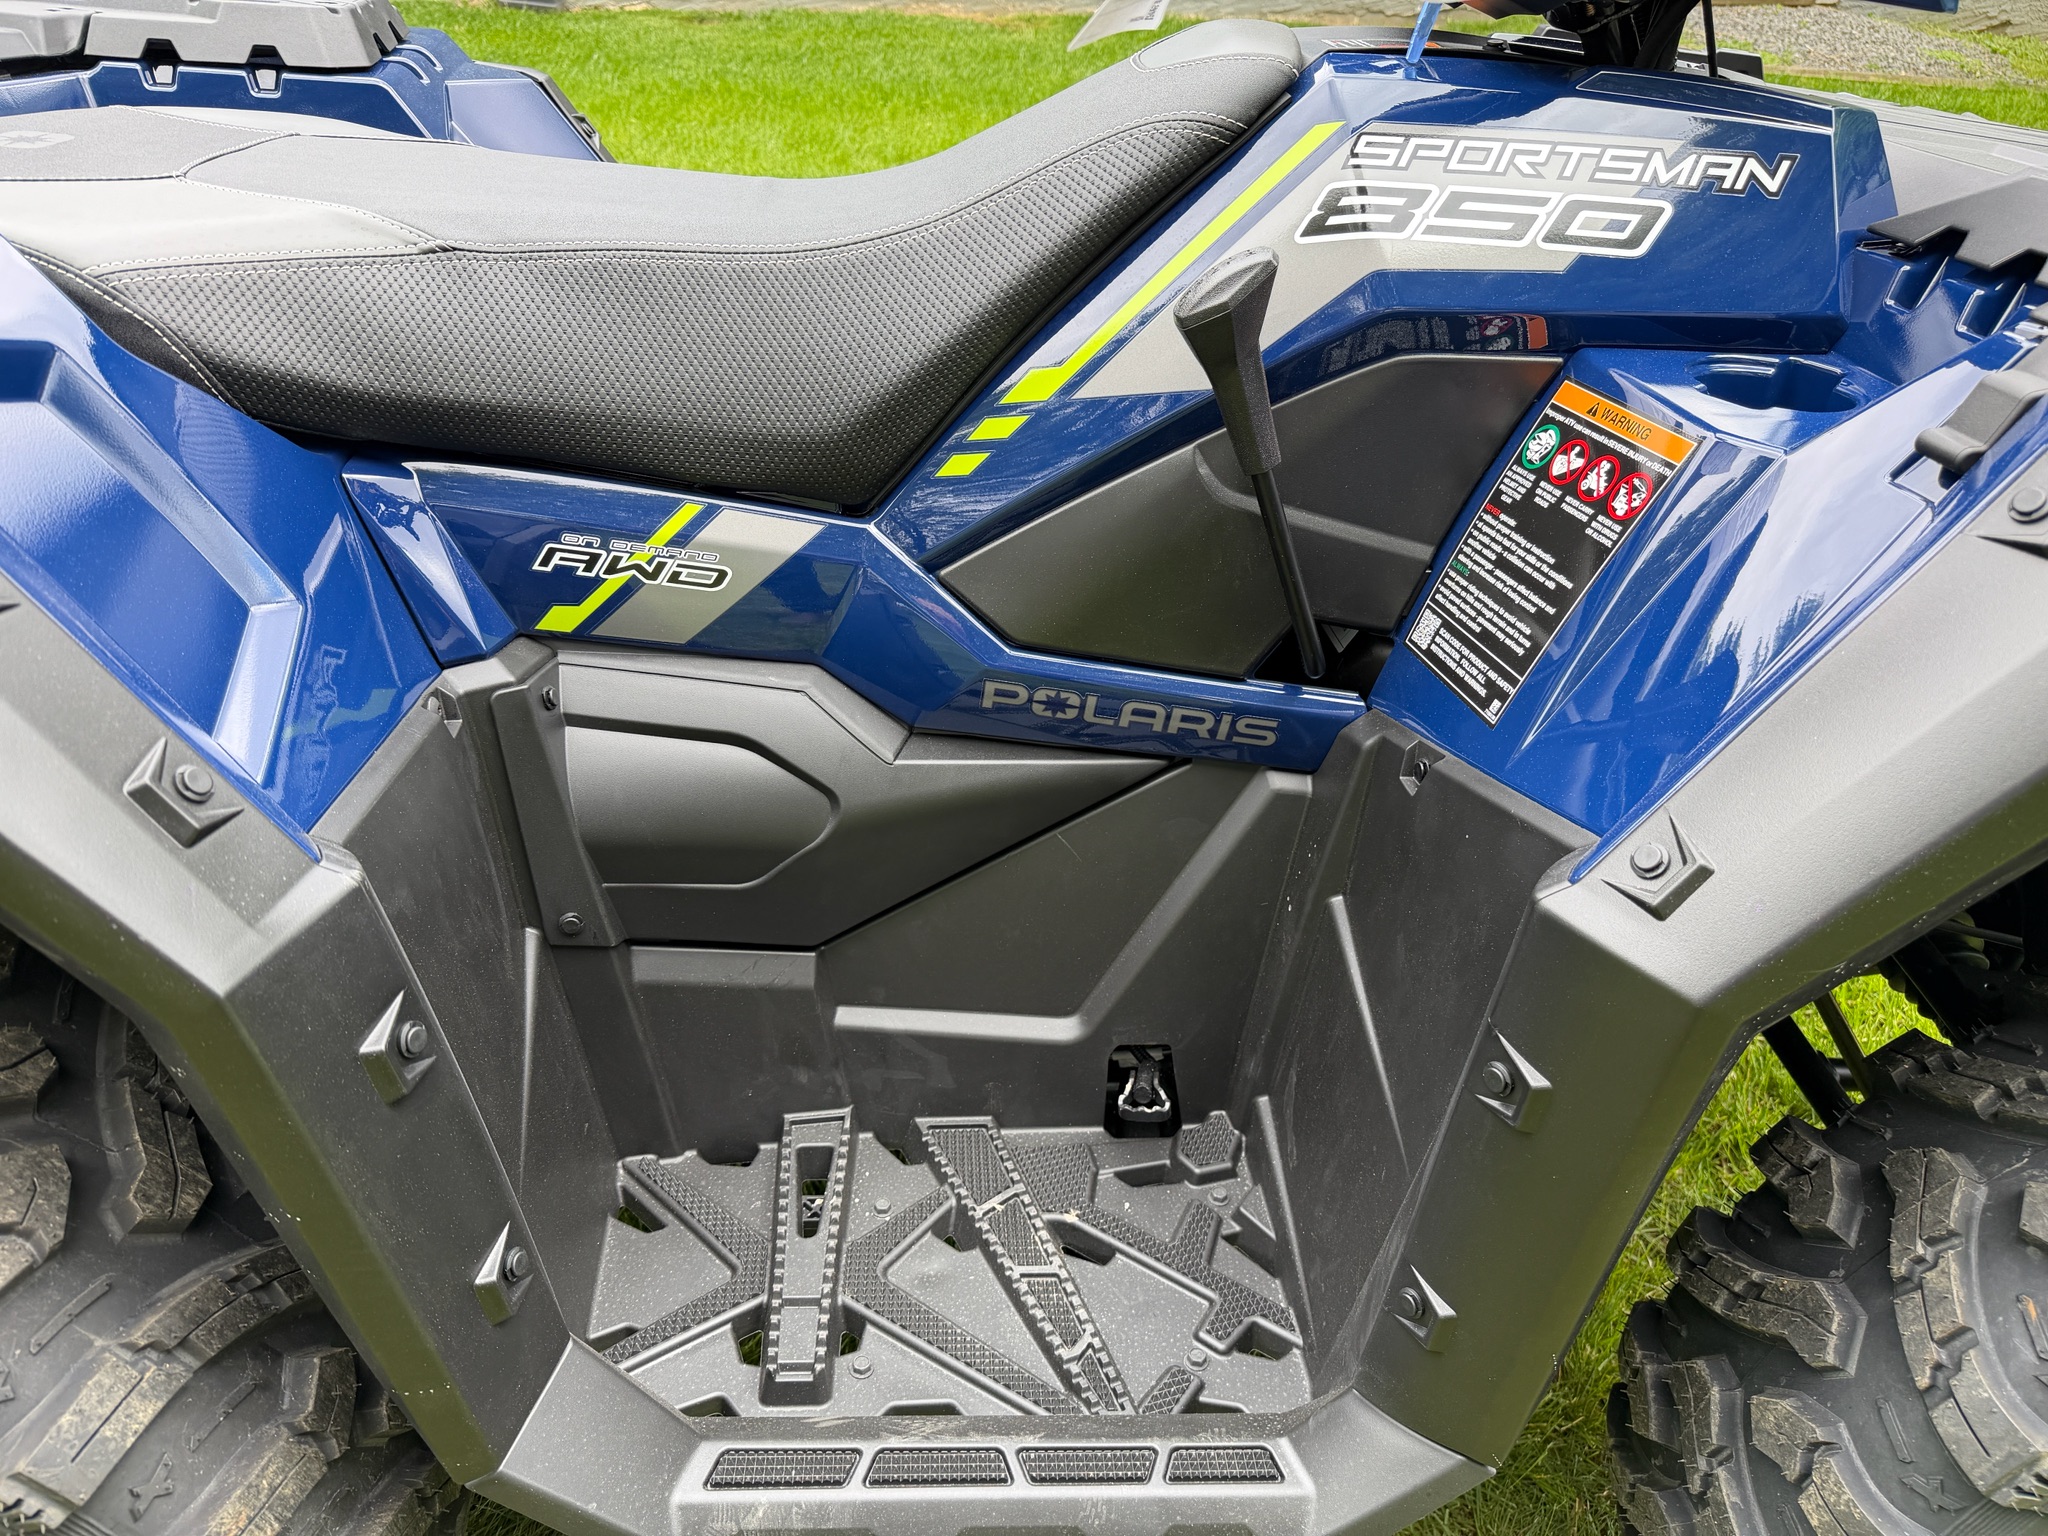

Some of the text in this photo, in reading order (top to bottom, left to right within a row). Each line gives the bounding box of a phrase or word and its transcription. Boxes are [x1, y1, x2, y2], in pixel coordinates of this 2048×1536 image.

[1342, 131, 1800, 199] SPORTSMAN
[1294, 180, 1674, 259] 850
[1600, 407, 1651, 440] WARNING
[1546, 408, 1566, 421] Improper
[1564, 417, 1576, 426] ATV
[1573, 423, 1583, 431] use
[1581, 427, 1591, 435] can
[1589, 432, 1605, 442] result
[1607, 439, 1629, 454] SEVERE
[1627, 450, 1648, 464] INJURY
[1645, 459, 1653, 467] or
[1650, 461, 1672, 476] DEATH
[1511, 464, 1536, 481] ALWAYS USE
[1539, 480, 1554, 492] NEVER
[1500, 494, 1512, 504] GEAR
[1564, 495, 1594, 515] NEVER CARRY
[1485, 503, 1500, 516] NEVER
[1560, 502, 1589, 522] PASSENGERS
[1596, 514, 1622, 532] NEVER USE
[1591, 531, 1612, 548] ALCOHOL
[1601, 527, 1618, 540] DRUGS
[562, 534, 720, 562] ON DEMAND
[531, 543, 733, 592] AWD
[1439, 627, 1515, 694] SCAN CODE FOR PRODUCT AND SAFETY
[1460, 658, 1479, 676] FOLLOW
[1455, 666, 1465, 677] AND
[980, 679, 1279, 747] POLARIS
